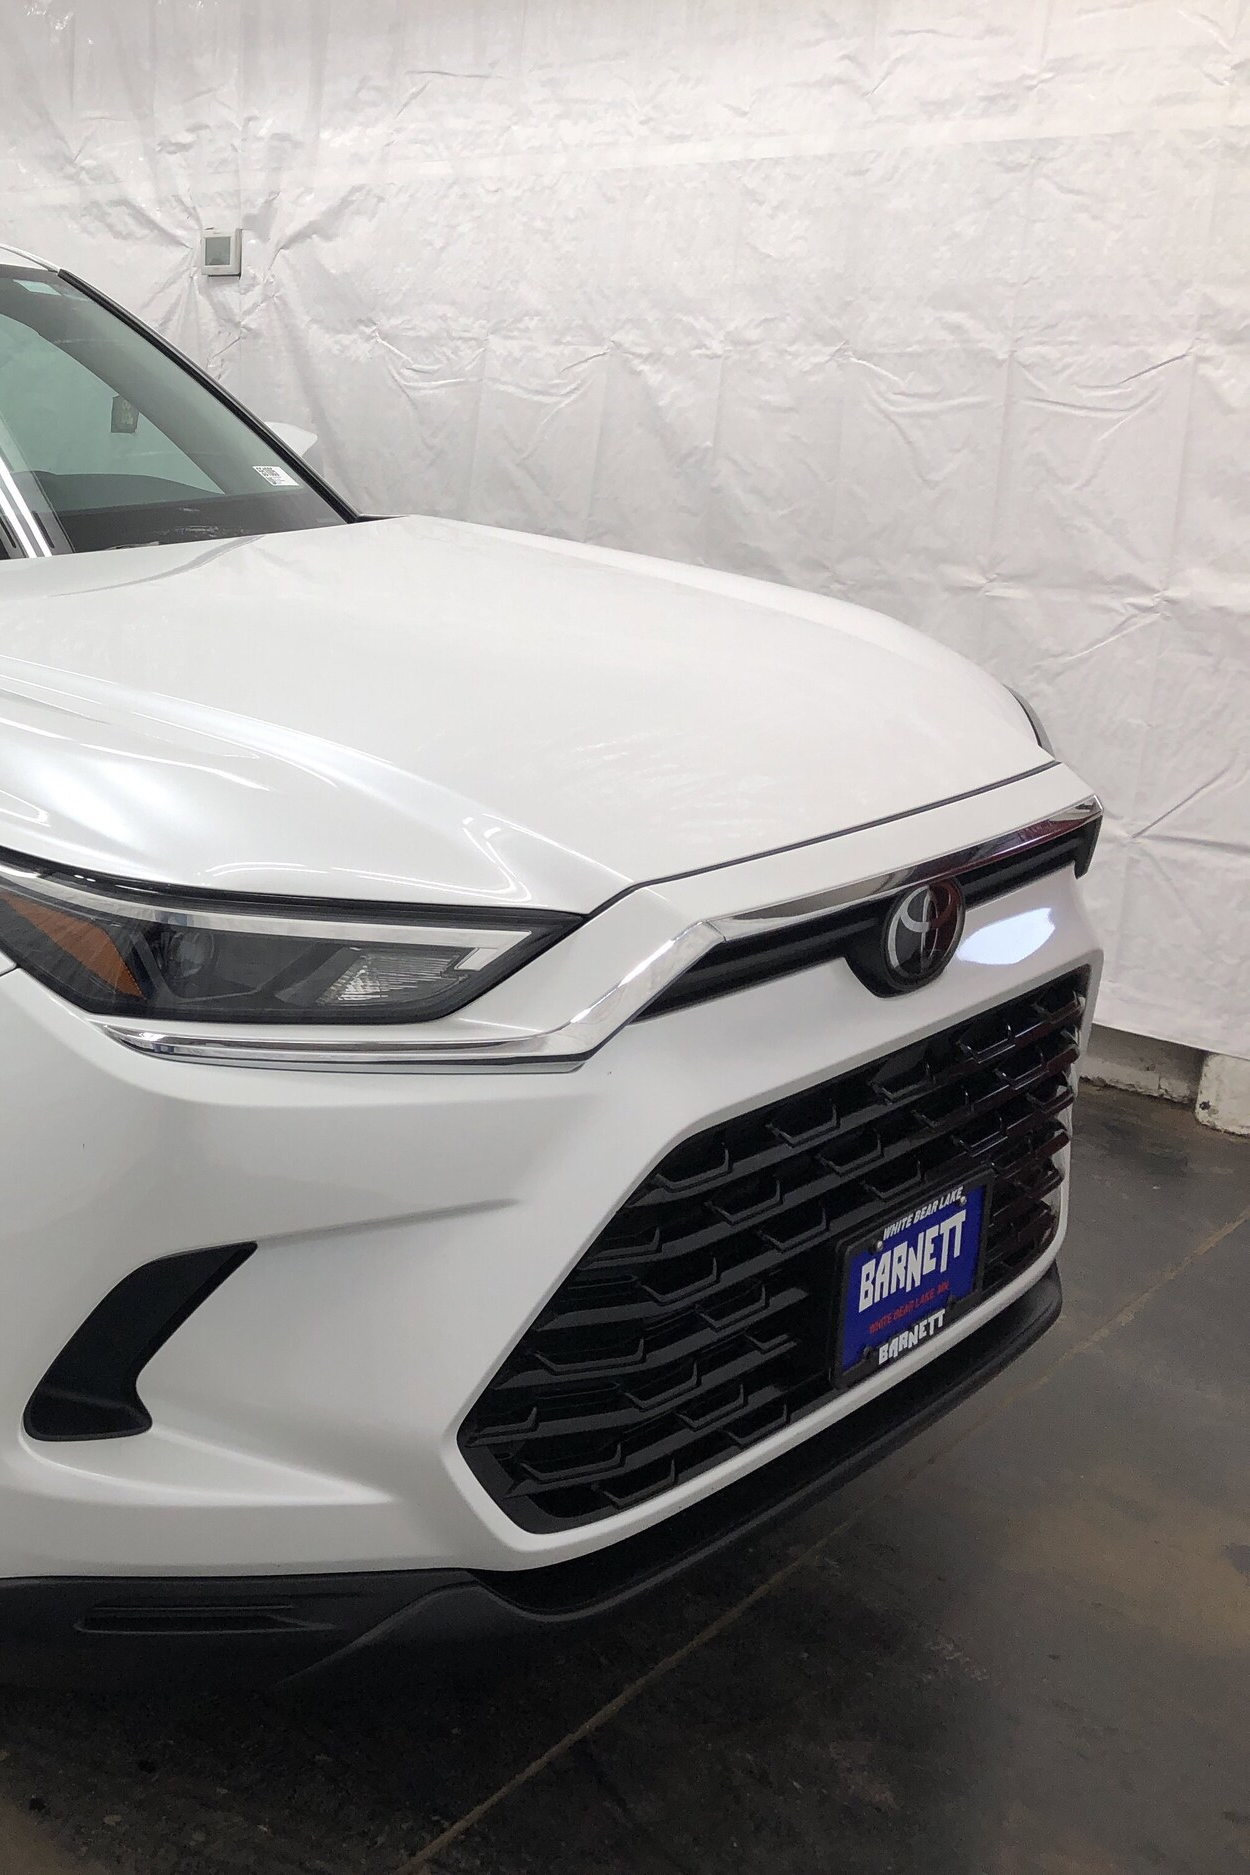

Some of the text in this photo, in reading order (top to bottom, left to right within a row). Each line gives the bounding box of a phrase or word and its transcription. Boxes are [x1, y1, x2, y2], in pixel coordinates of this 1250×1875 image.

[883, 1186, 964, 1241] WHITE BEAR LAKE
[859, 1209, 966, 1313] BARNETT
[878, 1308, 946, 1365] BARNETT
